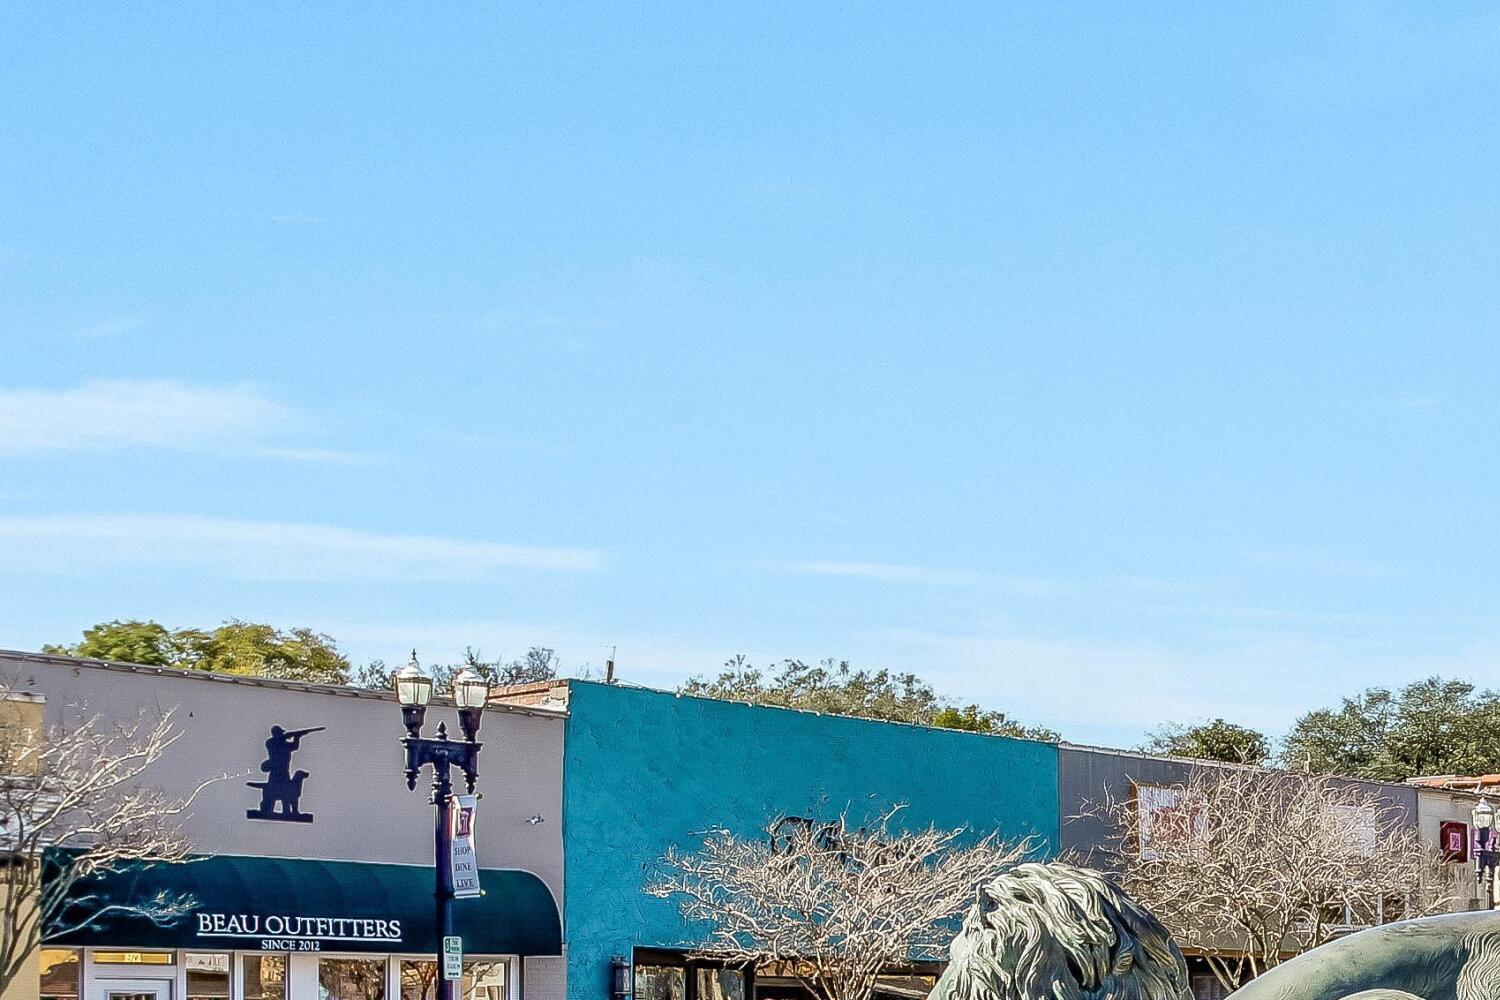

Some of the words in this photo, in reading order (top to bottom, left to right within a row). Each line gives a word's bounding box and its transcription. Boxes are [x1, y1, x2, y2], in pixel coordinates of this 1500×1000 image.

[454, 847, 471, 856] SHOP
[456, 878, 474, 888] LIVE
[197, 913, 259, 934] BEAU
[265, 915, 402, 938] OUTFITTERS
[261, 939, 296, 950] SINCE
[298, 940, 320, 951] 2012
